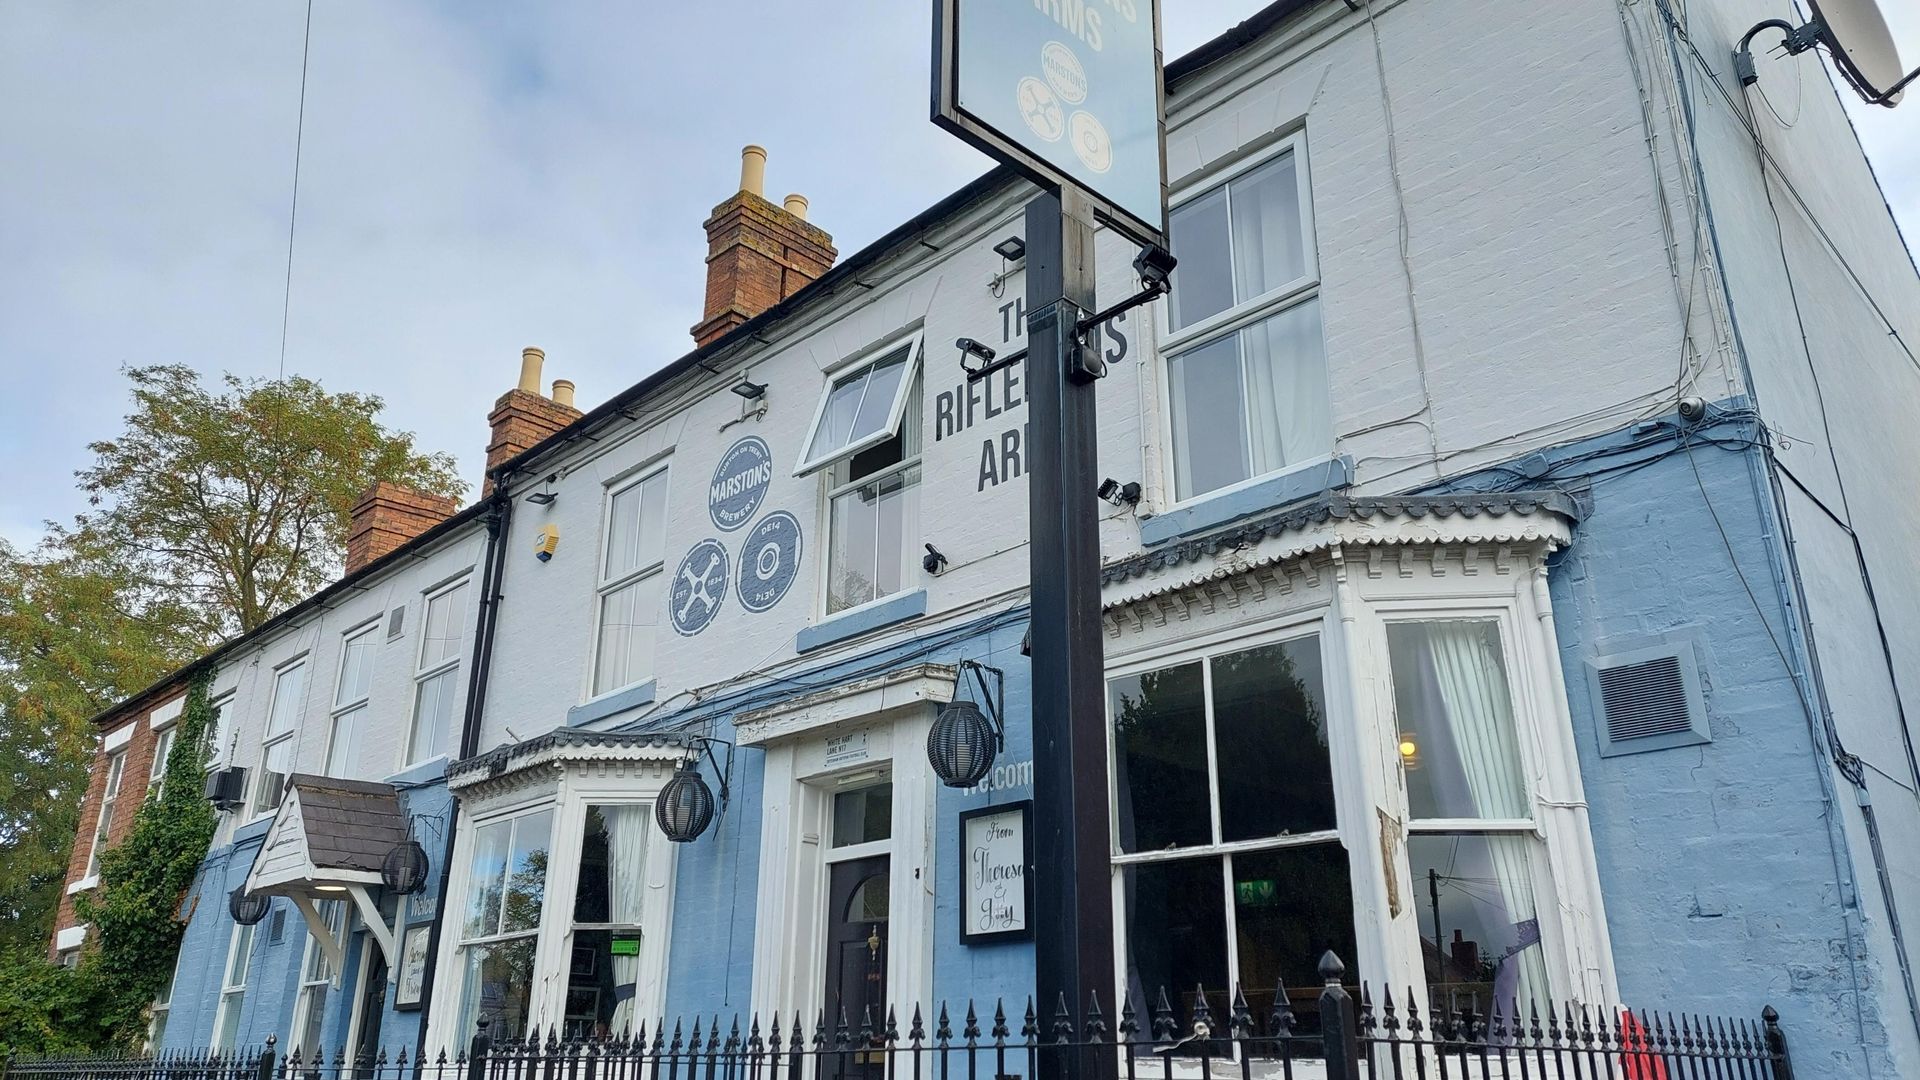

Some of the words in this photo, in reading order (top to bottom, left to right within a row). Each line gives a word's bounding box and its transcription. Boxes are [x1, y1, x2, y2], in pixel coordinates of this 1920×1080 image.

[719, 449, 740, 477] BURTON
[977, 422, 1030, 493] AR
[710, 460, 771, 506] MARSTON'S
[719, 496, 756, 522] BREWERY
[761, 521, 781, 535] DE14
[986, 821, 1014, 843] From
